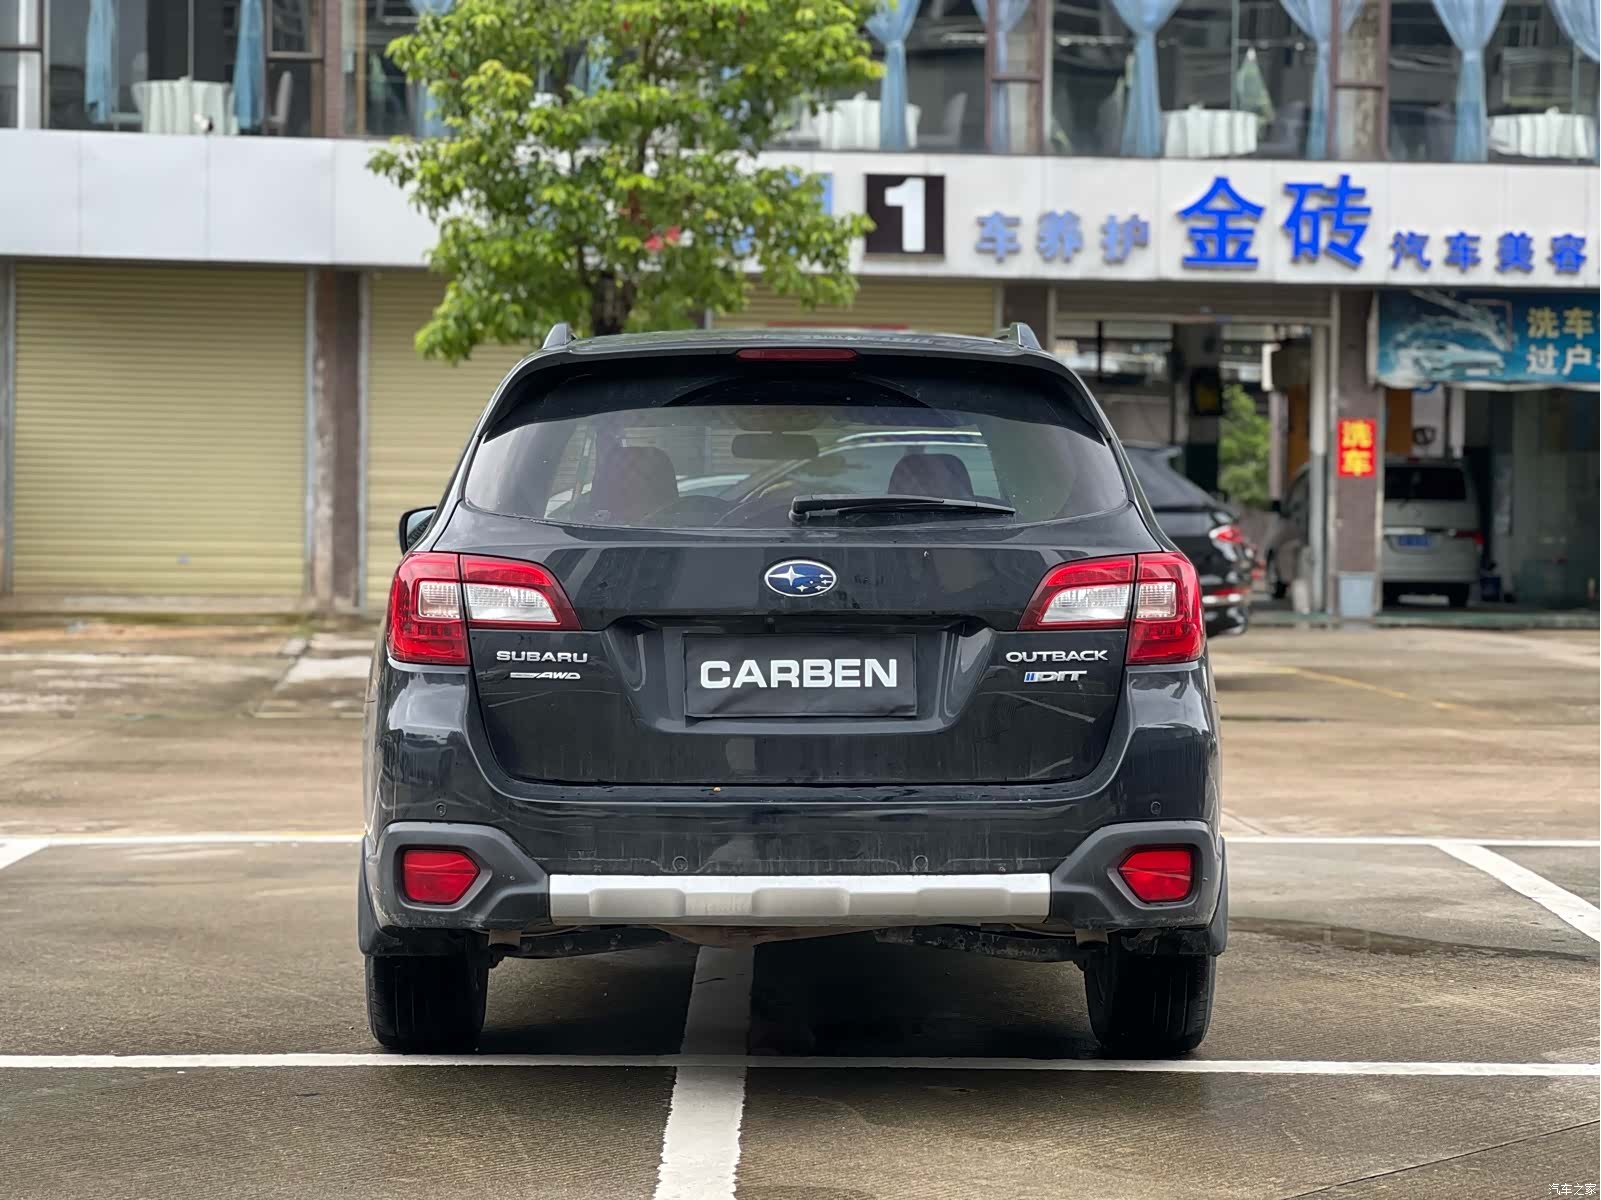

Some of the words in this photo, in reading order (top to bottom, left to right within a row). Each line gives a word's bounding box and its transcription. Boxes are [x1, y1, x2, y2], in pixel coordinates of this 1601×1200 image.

[884, 176, 926, 253] 1
[1177, 174, 1373, 271] 金砖
[1391, 231, 1600, 274] 汽车美容
[975, 210, 1151, 264] 车养护
[1527, 306, 1600, 340] 洗车
[1526, 342, 1600, 377] 过户
[496, 650, 589, 664] SUBARU
[1005, 650, 1109, 663] OUTBACK
[536, 671, 581, 680] AWD
[700, 658, 898, 690] CARBEN
